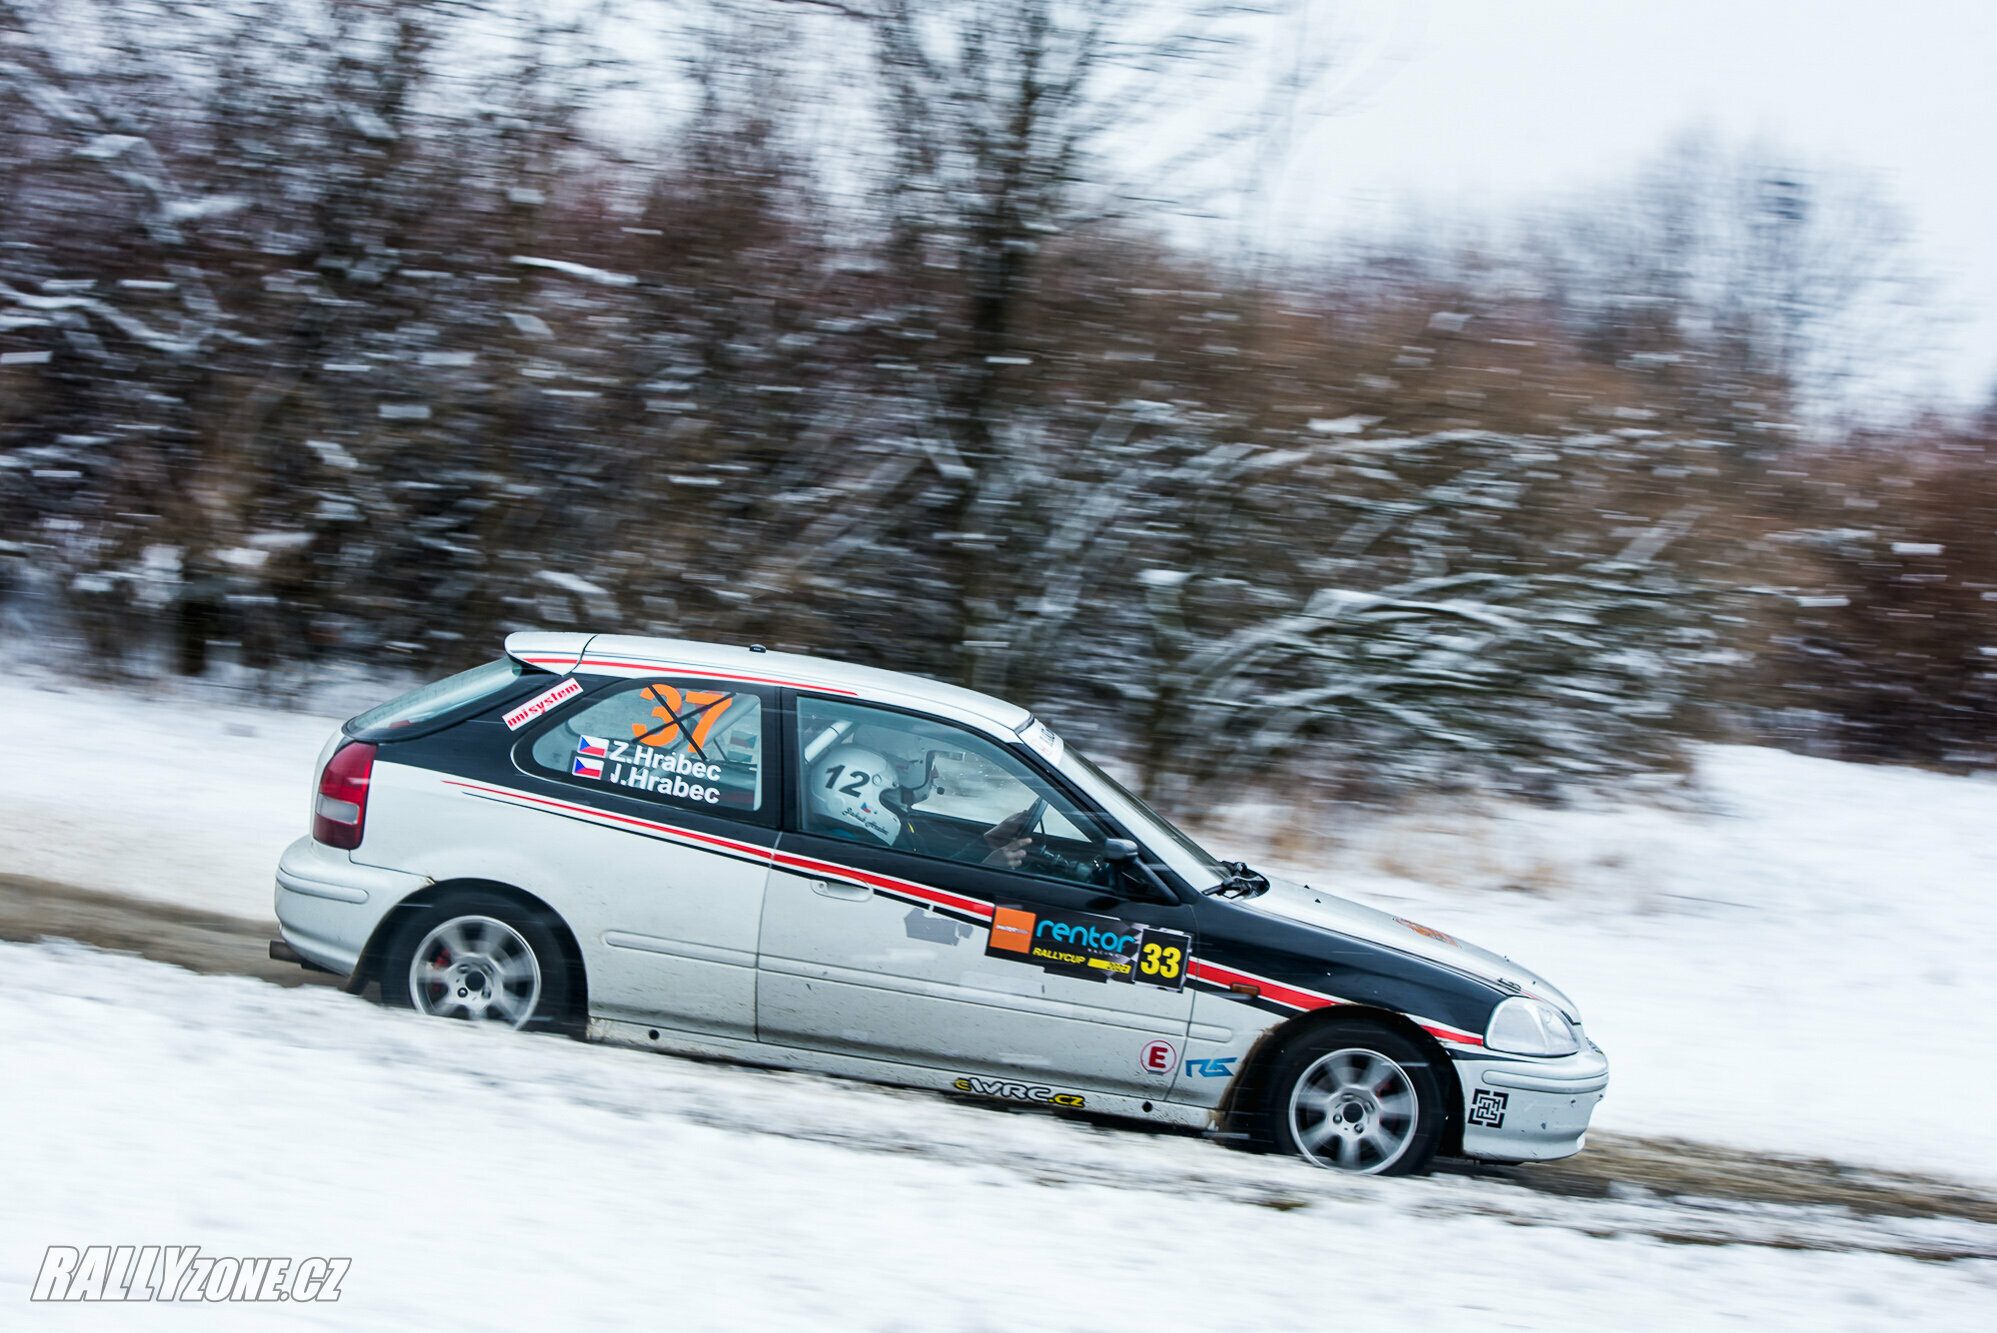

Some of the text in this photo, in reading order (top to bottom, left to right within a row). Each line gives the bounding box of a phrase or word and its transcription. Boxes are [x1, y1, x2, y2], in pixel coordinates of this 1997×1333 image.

[631, 683, 733, 753] 37
[608, 740, 722, 781] Z.Hrabec
[609, 763, 721, 804] J.Hrabec
[825, 764, 870, 798] 12
[1035, 919, 1136, 953] rentor
[1140, 942, 1182, 979] 33
[1148, 1046, 1169, 1069] E
